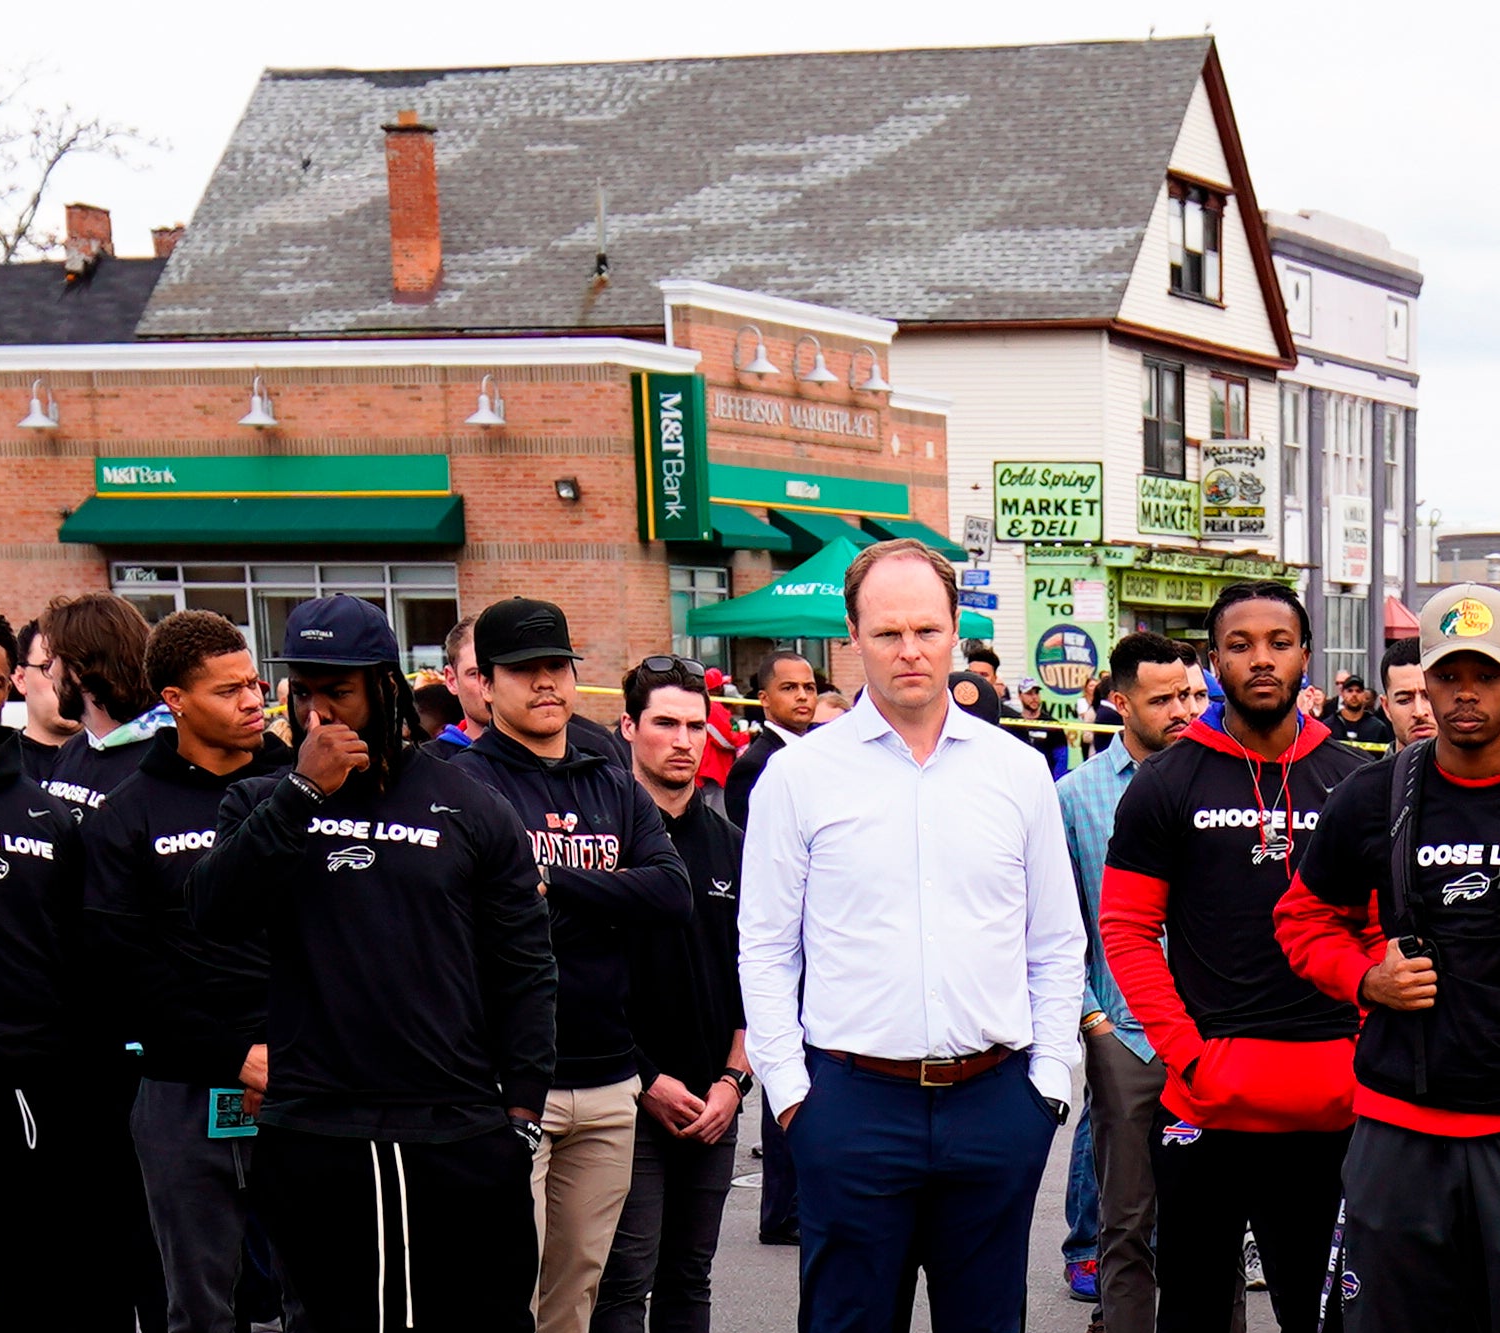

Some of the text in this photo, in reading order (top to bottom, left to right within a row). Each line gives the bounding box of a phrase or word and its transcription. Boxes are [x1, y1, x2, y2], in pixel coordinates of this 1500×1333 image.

[713, 393, 875, 438] JEFFERSON MARKETPLACE
[658, 391, 686, 520] M&T Bank
[140, 466, 177, 483] Bank
[1000, 467, 1097, 493] Cold Spring
[1001, 498, 1099, 517] MARKET
[1141, 501, 1192, 531] MARKET
[967, 519, 989, 532] ONE
[1007, 518, 1077, 537] & DELI
[820, 582, 845, 596] Ba
[1033, 577, 1086, 600] PLA
[1046, 604, 1073, 616] TO
[88, 790, 106, 809] LO
[1194, 808, 1319, 831] CHOOSE LO
[154, 830, 216, 855] CHOO
[308, 817, 440, 848] OSE LOVE
[4, 834, 54, 860] LOVE
[1417, 844, 1484, 867] OOSE
